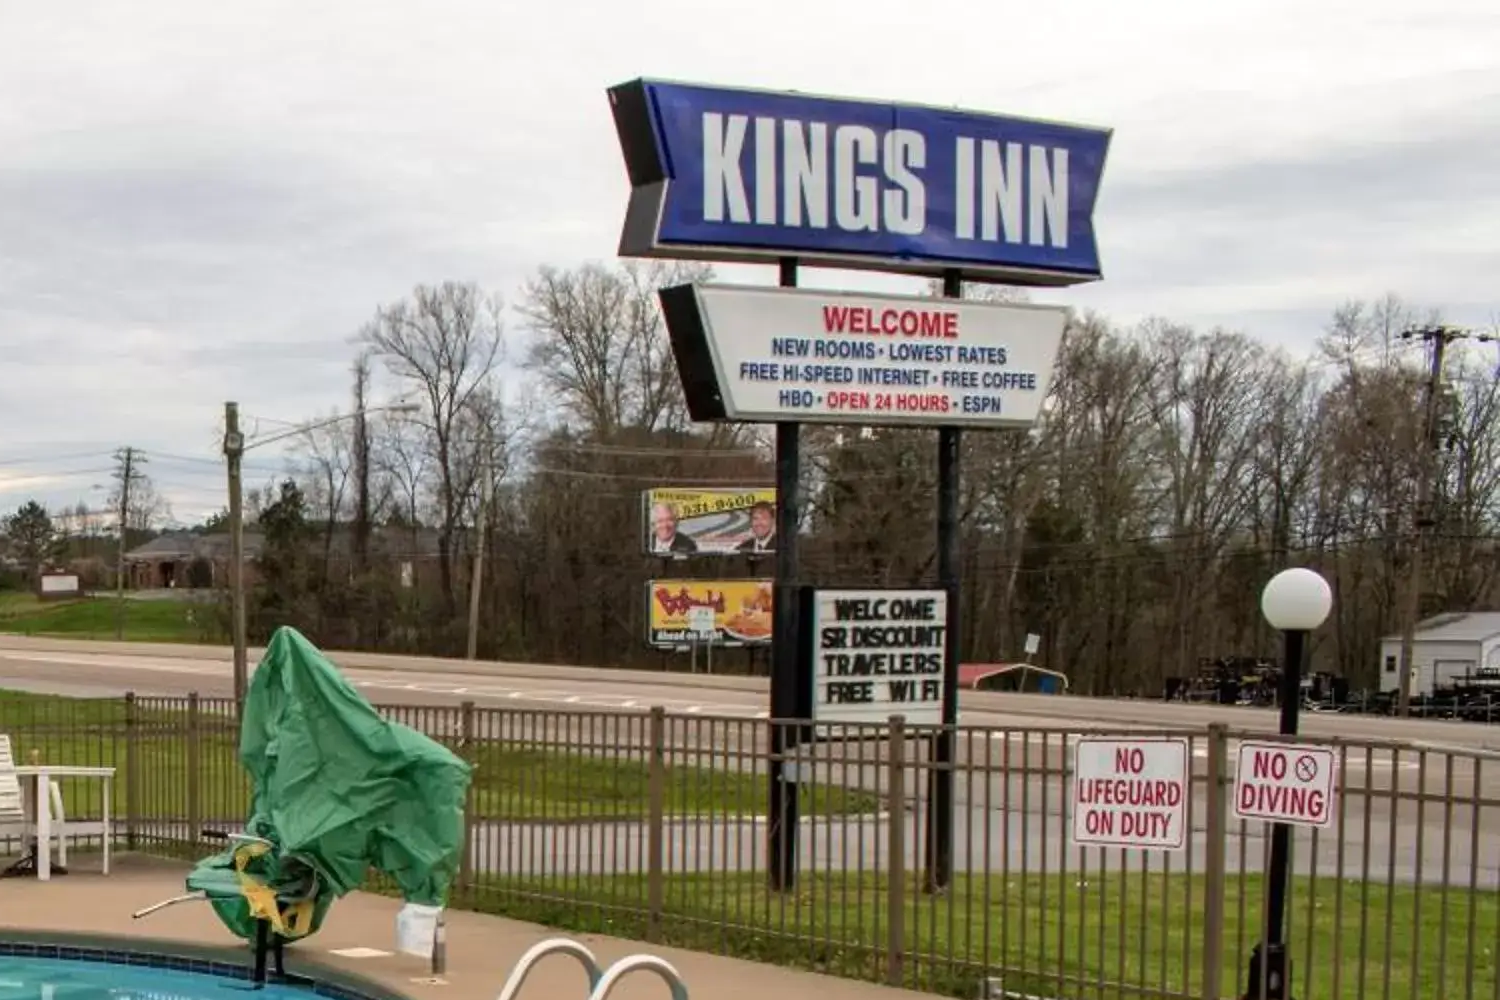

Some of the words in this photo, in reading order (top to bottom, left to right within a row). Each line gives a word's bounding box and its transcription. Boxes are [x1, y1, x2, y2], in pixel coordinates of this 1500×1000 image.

[702, 112, 927, 235] KINGS
[955, 136, 1069, 249] INN
[823, 305, 959, 338] WELCOME
[771, 337, 811, 358] NEW
[814, 340, 876, 360] ROOMS
[889, 343, 954, 363] LOWEST
[958, 347, 1007, 366] RATES
[740, 362, 779, 381] FREE
[783, 365, 853, 384] HI-SPEED
[858, 368, 929, 386] INTERNET
[942, 371, 979, 388] FREE
[982, 372, 1036, 390] COFFEE
[779, 390, 814, 407] HBO
[827, 391, 869, 410] OPEN
[875, 393, 892, 410] 24
[896, 393, 949, 412] HOURS
[963, 395, 1001, 413] ESPN
[835, 599, 936, 620] WELCOME
[821, 627, 847, 648] SR
[851, 626, 946, 648] DISCOUNT
[824, 653, 941, 676] TRAVELERS
[826, 681, 874, 704] FREE
[1115, 747, 1145, 774] NO
[1253, 751, 1288, 780] NO
[1079, 778, 1181, 807] LIFEGUARD
[1241, 783, 1324, 817] DIVING
[1086, 809, 1113, 835] ON
[1121, 813, 1172, 839] DUTY
